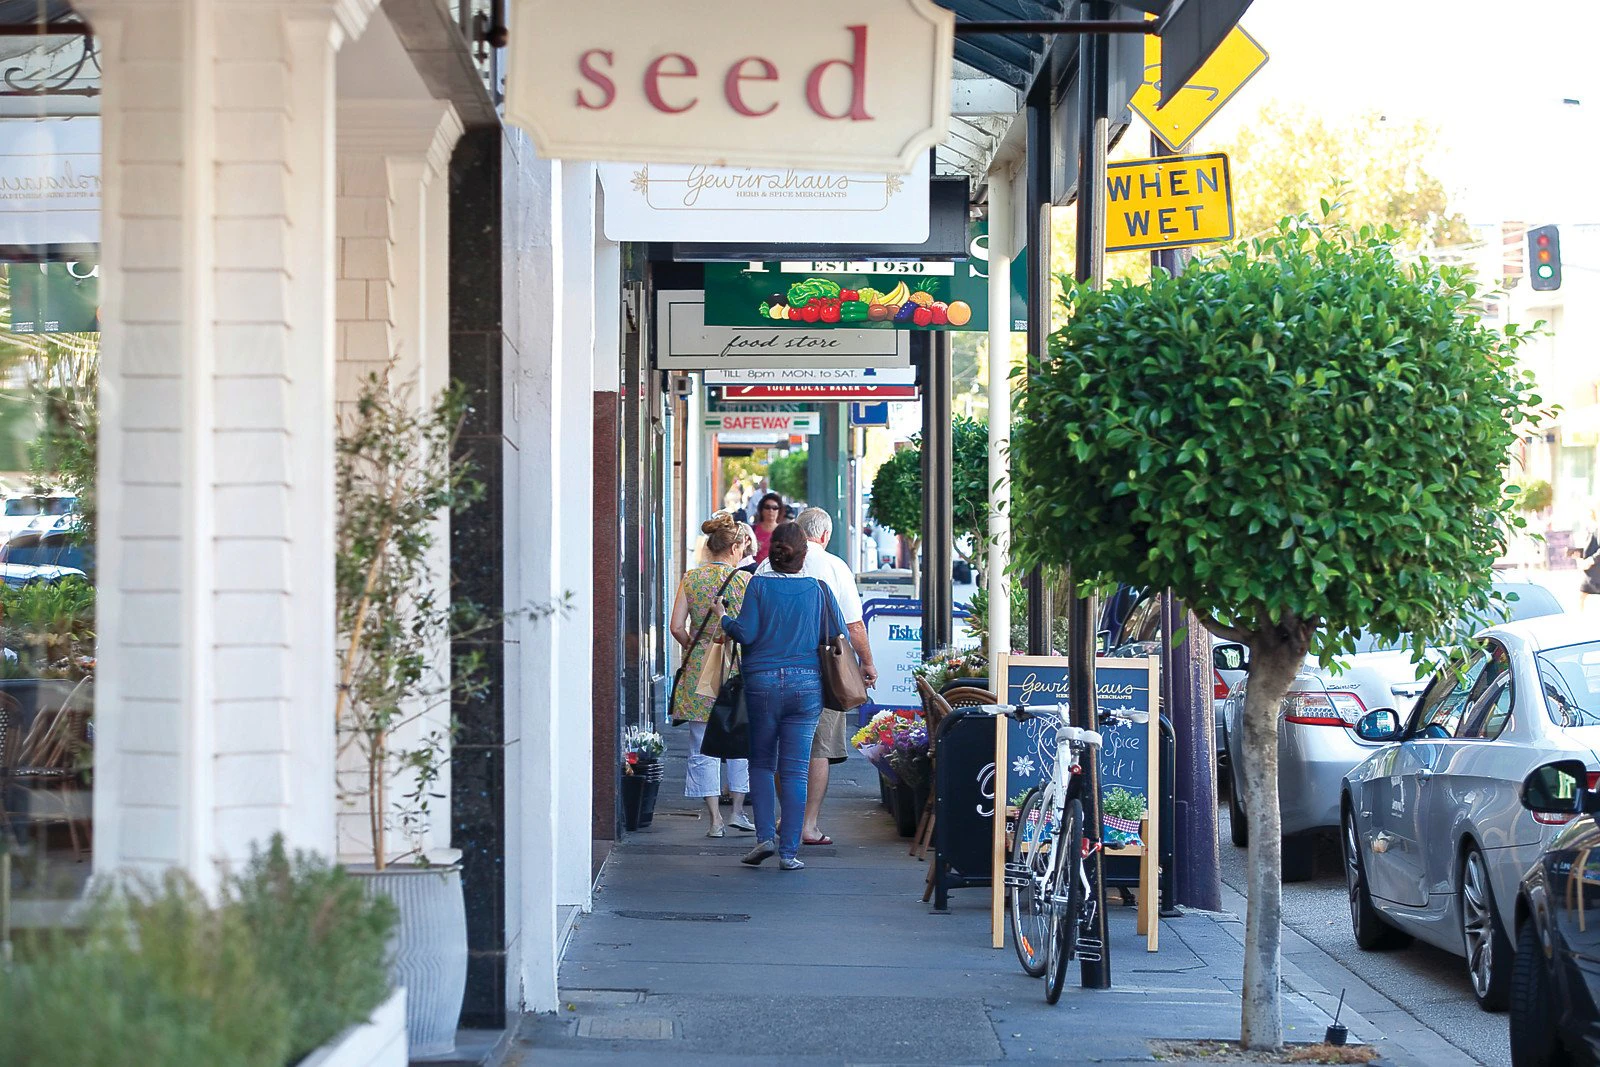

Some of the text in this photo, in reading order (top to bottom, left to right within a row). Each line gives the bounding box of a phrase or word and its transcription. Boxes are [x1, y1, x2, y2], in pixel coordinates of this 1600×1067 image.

[575, 24, 874, 122] seed
[1106, 167, 1218, 202] WHEN
[1123, 205, 1204, 237] WET
[810, 261, 925, 273] EST. 1950
[720, 335, 842, 357] food store
[747, 370, 775, 380] 8pm
[781, 370, 816, 378] MON.
[819, 370, 832, 378] to
[834, 370, 857, 378] SAT.
[723, 416, 790, 430] SAFEWAY
[888, 624, 912, 640] Fish
[1104, 732, 1140, 759] Spice
